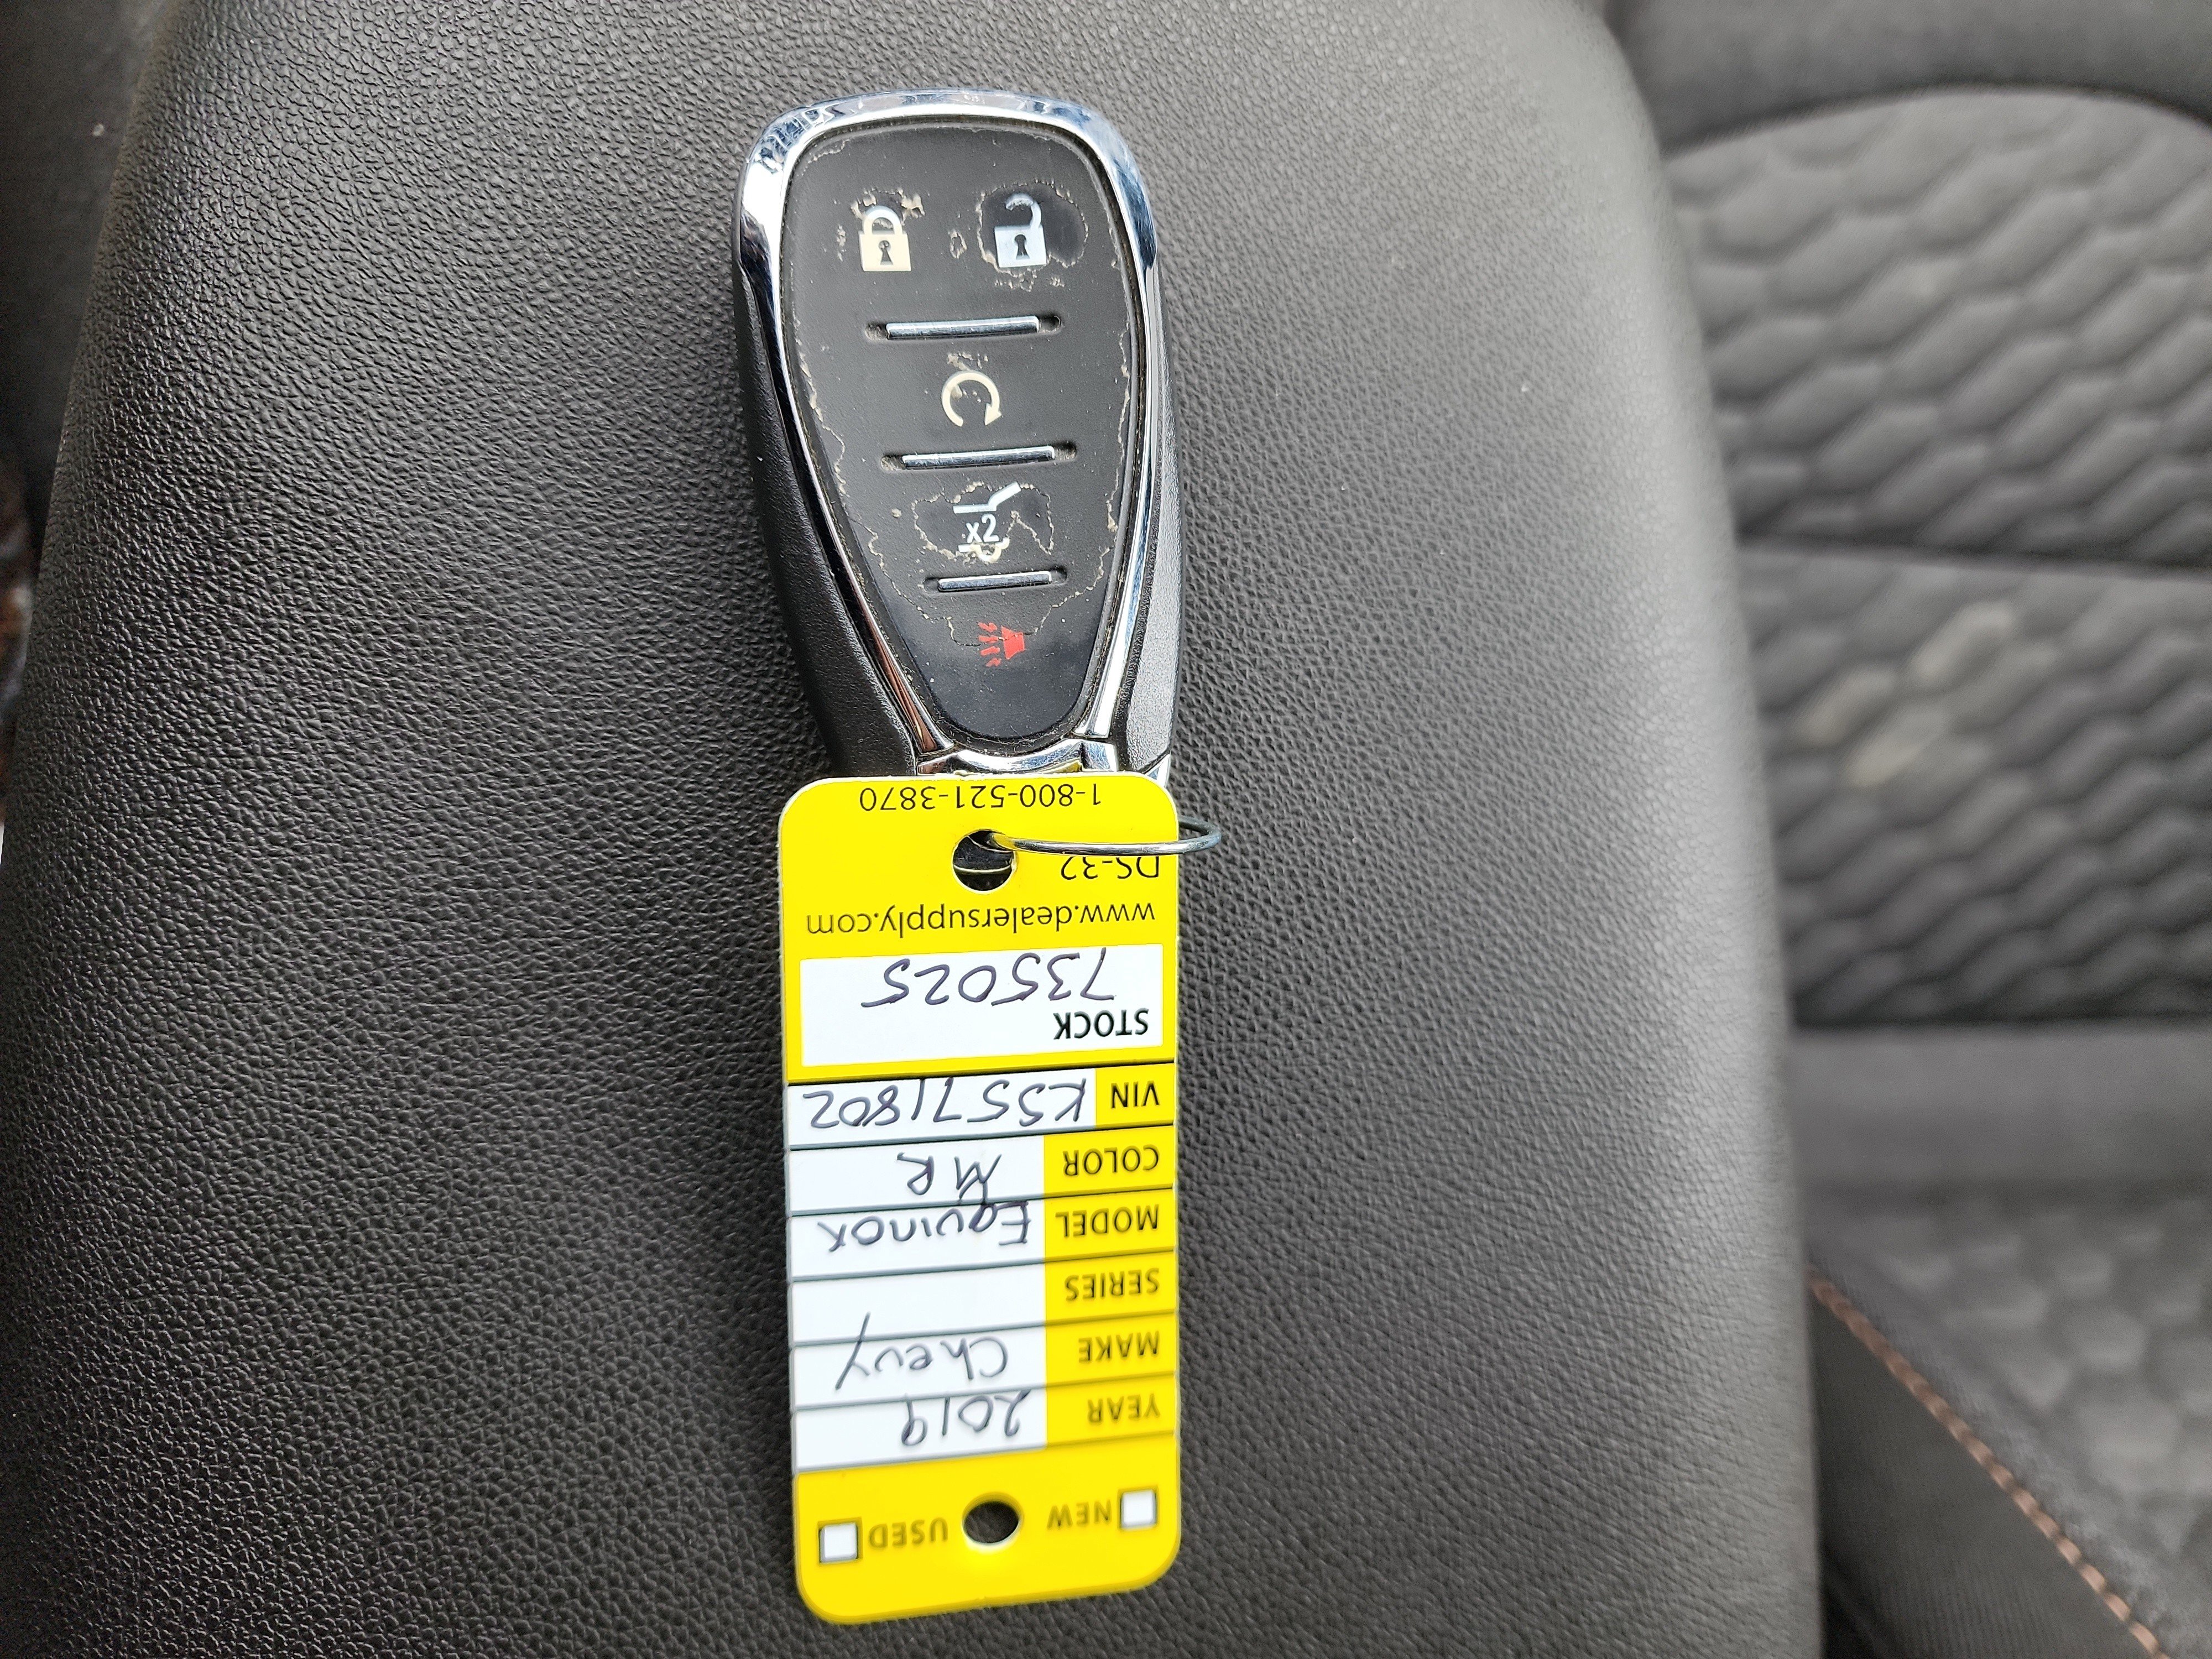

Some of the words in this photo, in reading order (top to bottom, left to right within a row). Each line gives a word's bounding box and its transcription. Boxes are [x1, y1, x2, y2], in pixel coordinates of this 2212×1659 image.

[966, 513, 1000, 543] x2
[859, 782, 1100, 811] 1-800-521-3870
[1060, 855, 1159, 879] DS-32
[806, 901, 1154, 937] www.dealersupply.com
[860, 947, 1114, 1006] 735025
[1052, 1008, 1149, 1040] STOCK
[1110, 1081, 1158, 1109] VIN
[1062, 1146, 1158, 1176] COLOR
[1055, 1204, 1158, 1237] MODEL
[1063, 1268, 1159, 1301] SERIES
[834, 1312, 1008, 1391] Chevy
[1077, 1331, 1159, 1363] MAKE
[900, 1389, 1030, 1446] 2019
[1087, 1393, 1159, 1423] YEAR
[1047, 1499, 1111, 1530] NEW
[868, 1517, 948, 1548] USED
